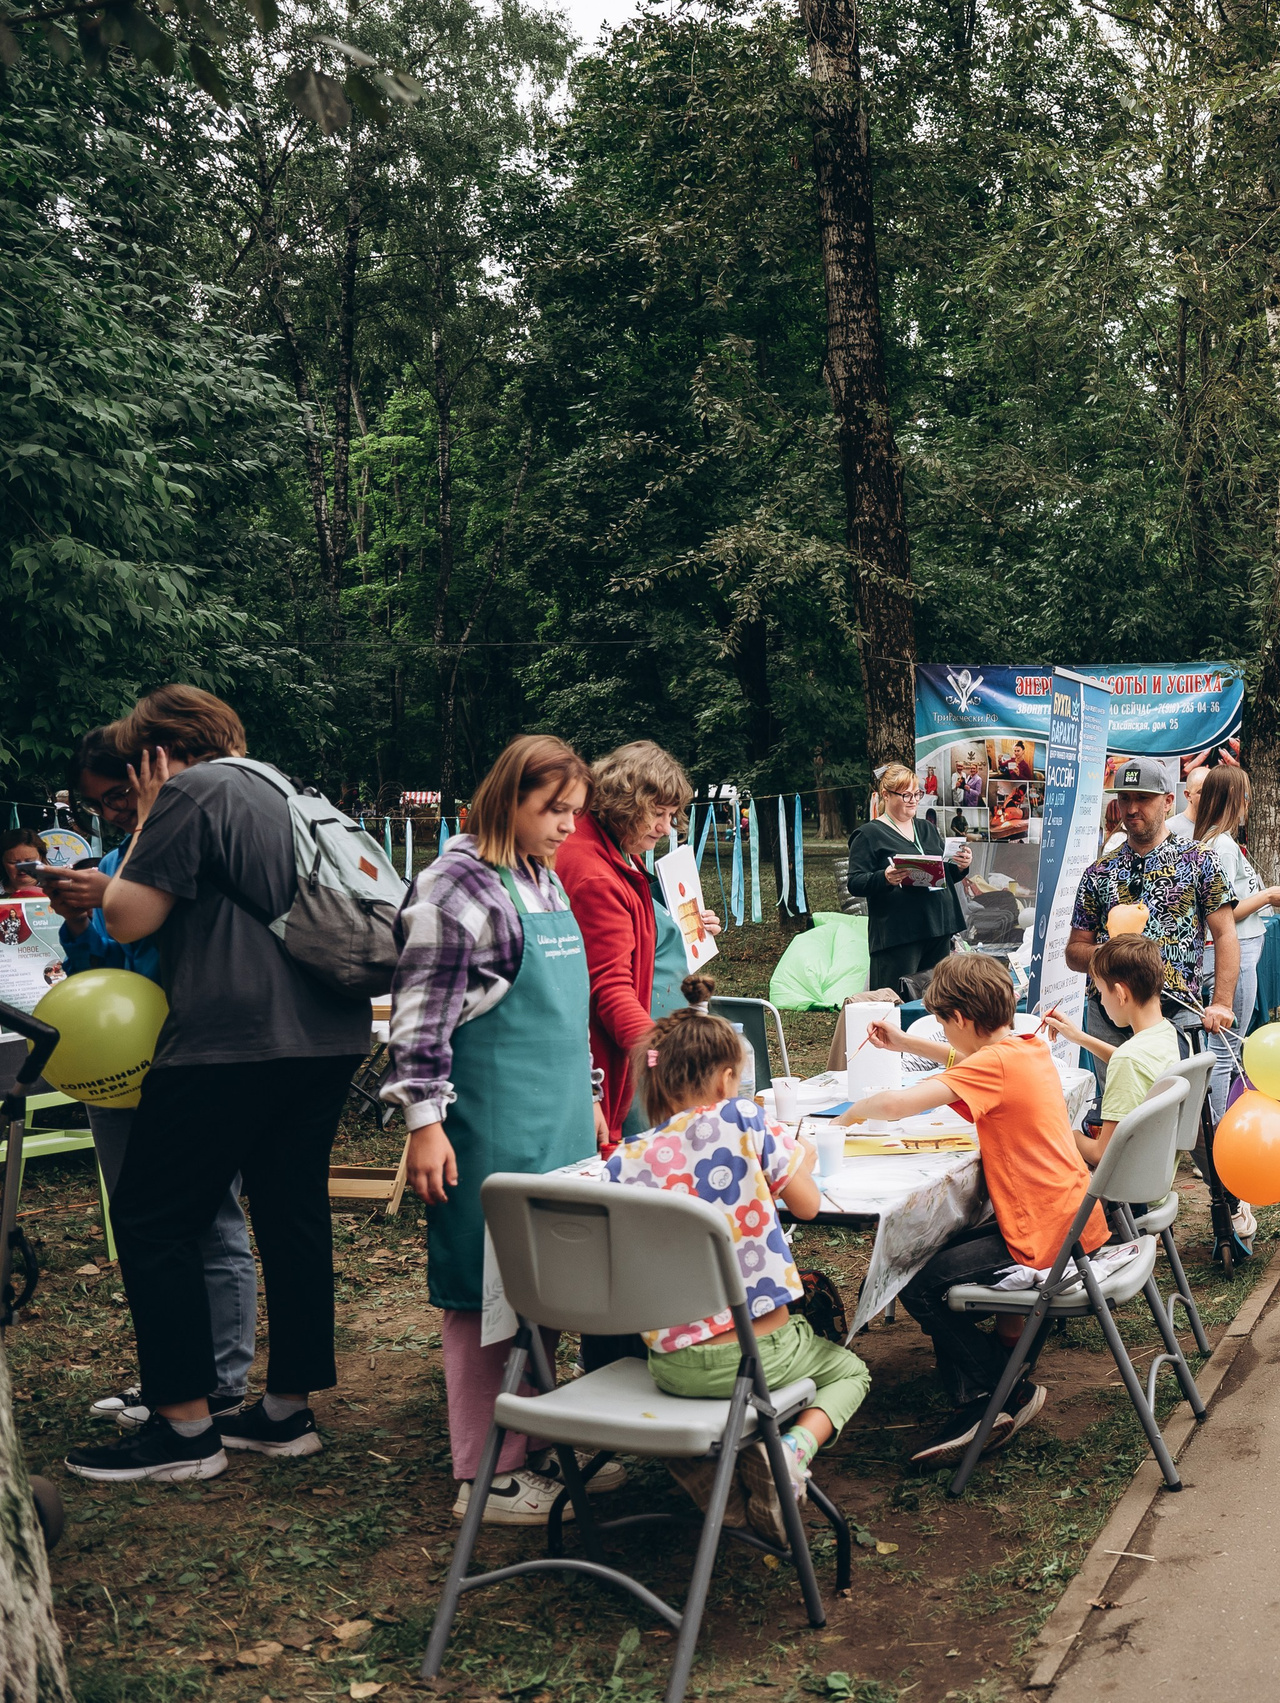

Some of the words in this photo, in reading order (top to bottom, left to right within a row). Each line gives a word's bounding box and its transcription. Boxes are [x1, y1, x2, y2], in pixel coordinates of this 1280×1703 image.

[1151, 675, 1162, 695] И
[1166, 673, 1223, 694] УСПЕХА
[1053, 692, 1072, 718] БУХТА
[1121, 702, 1152, 716] СЕЙЧАС
[1169, 718, 1179, 730] 25
[1051, 719, 1078, 748] БАРАХТА
[1047, 808, 1053, 826] 2
[1046, 830, 1052, 848] 7
[17, 945, 39, 954] НОВОЕ
[17, 952, 51, 960] ПРОСТРАНСТВО
[60, 1059, 151, 1090] СОЛНЕЧНЫЙ
[88, 1081, 129, 1096] ПАРК
